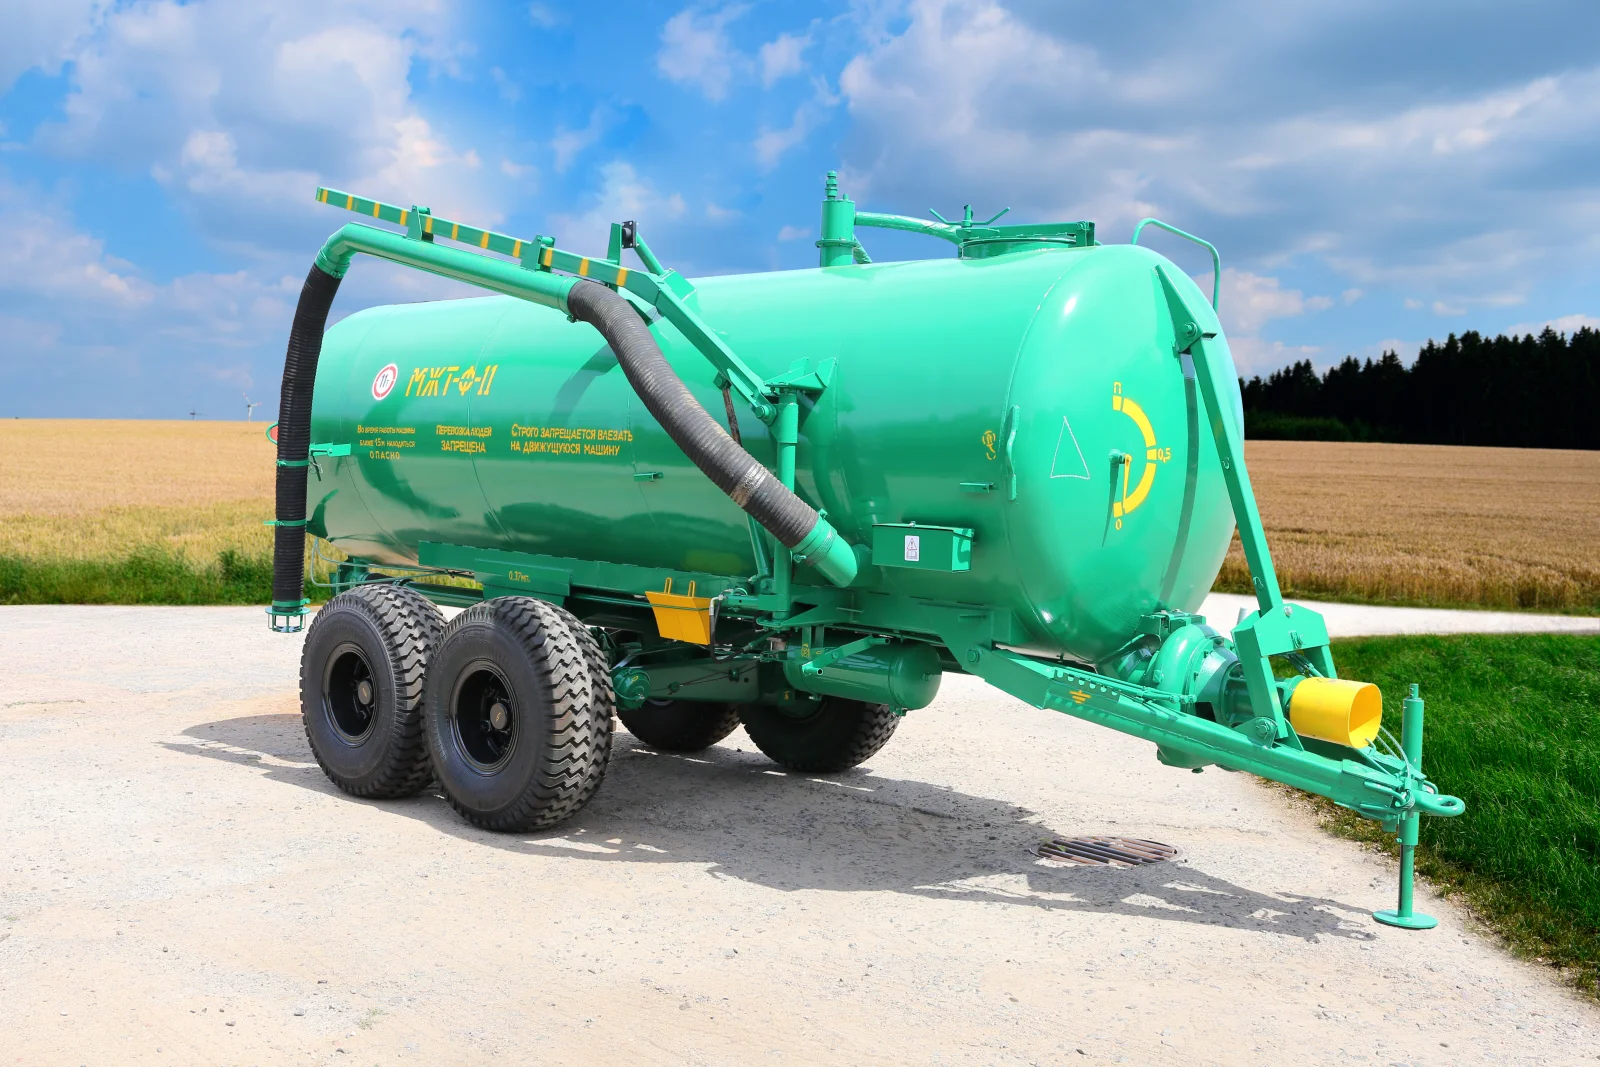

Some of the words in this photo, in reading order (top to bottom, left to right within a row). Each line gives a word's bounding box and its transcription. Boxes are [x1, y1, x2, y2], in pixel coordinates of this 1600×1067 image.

[405, 364, 498, 397] МЖТ-Ф-11
[436, 424, 470, 436] ПЕРЕВОЗКА
[540, 427, 596, 441] ЗАПРЕЩАЕТСЯ
[597, 429, 633, 442] ВЛЕЗАТЬ
[441, 440, 486, 455] ЗАПРЕЩЕНА
[510, 440, 521, 451] НА
[522, 441, 581, 455] ДВИЖУЩУЮСЯ
[583, 444, 621, 456] МАШИНУ
